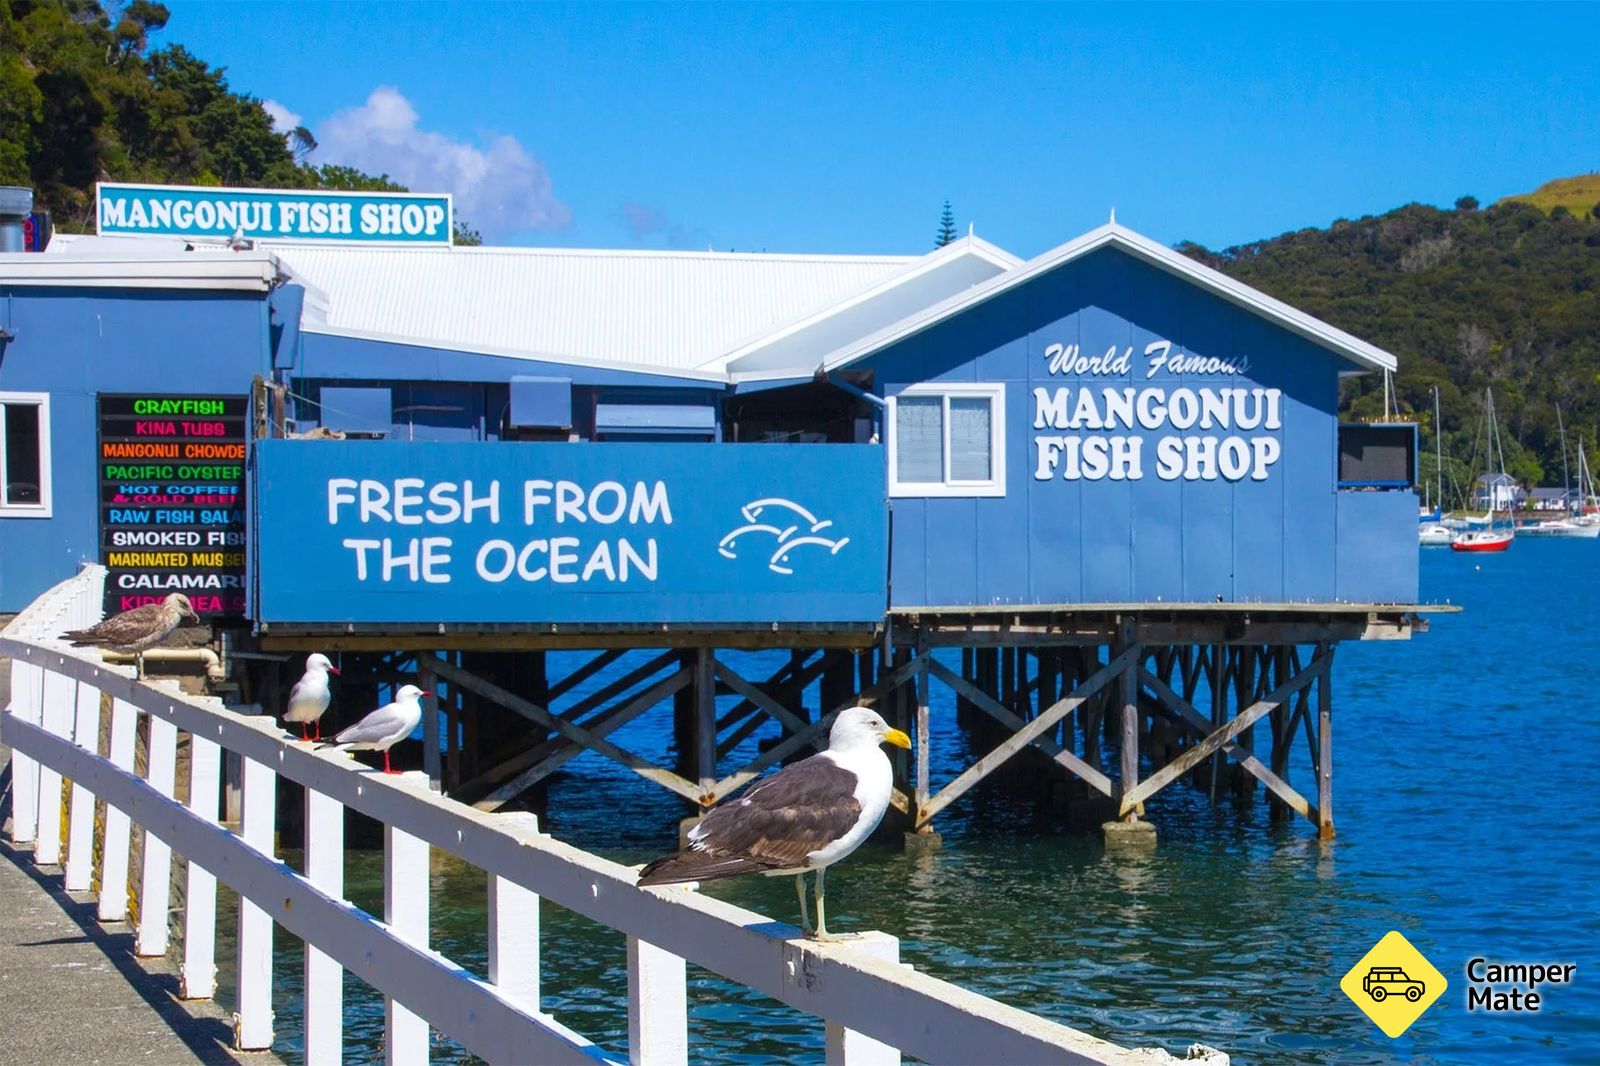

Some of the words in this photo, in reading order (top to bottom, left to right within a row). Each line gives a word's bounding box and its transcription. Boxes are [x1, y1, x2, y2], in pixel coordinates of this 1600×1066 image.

[101, 197, 272, 232] MANGONUI
[278, 200, 352, 233] FISH
[359, 202, 444, 236] SHOP
[1044, 342, 1133, 377] World
[1144, 340, 1251, 378] Famous
[134, 400, 225, 415] CRAYFISH
[1033, 387, 1282, 430] MANGONUI
[136, 422, 176, 435] KINA
[182, 422, 226, 436] TUBS
[103, 444, 178, 458] MANGONUI
[1034, 435, 1143, 481] FISH
[1155, 435, 1281, 481] SHOP
[106, 466, 173, 479] PACIFIC
[119, 485, 159, 494] HOT
[112, 495, 130, 504] &
[133, 495, 185, 504] COLD
[328, 478, 500, 525] FRESH
[524, 479, 673, 526] FROM
[110, 510, 150, 524] RAW
[156, 510, 195, 524] FISH
[113, 532, 200, 546] SMOKED
[109, 553, 188, 567] MARINATED
[342, 537, 453, 583] THE
[475, 537, 658, 584] OCEAN
